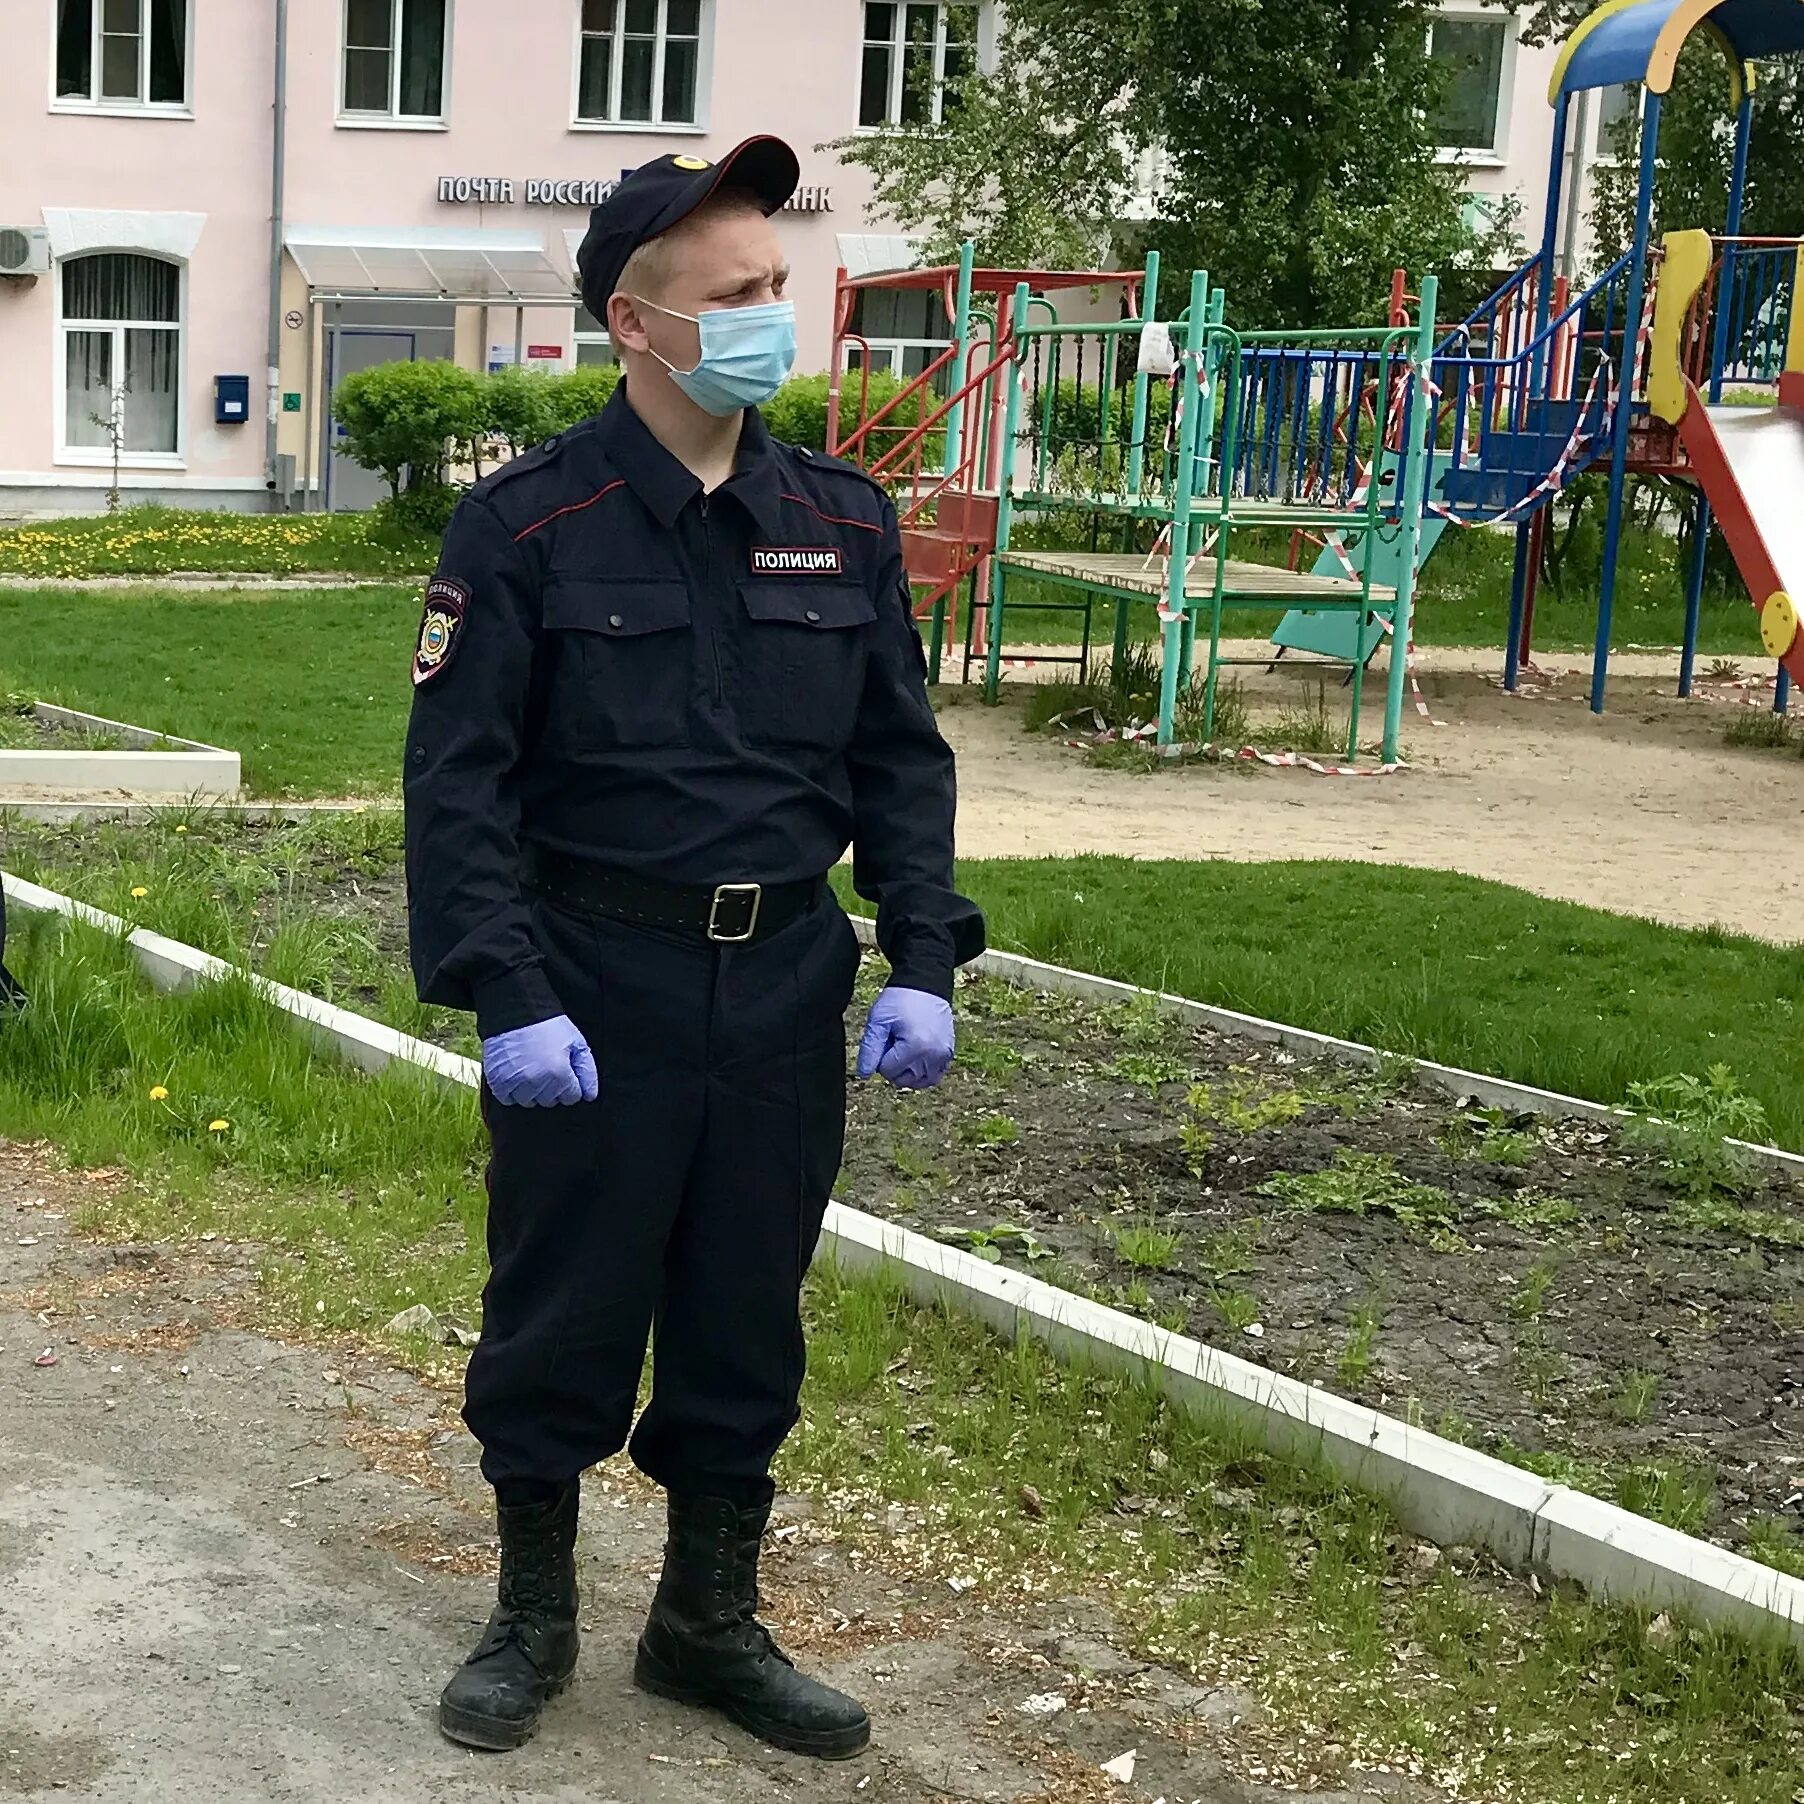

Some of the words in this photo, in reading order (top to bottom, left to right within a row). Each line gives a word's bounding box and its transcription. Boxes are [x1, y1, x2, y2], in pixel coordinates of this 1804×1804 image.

[438, 177, 514, 203] ПОЧТА
[526, 179, 613, 205] РОССИИ
[783, 186, 834, 212] АНК
[754, 551, 837, 570] ПОЛИЦИЯ
